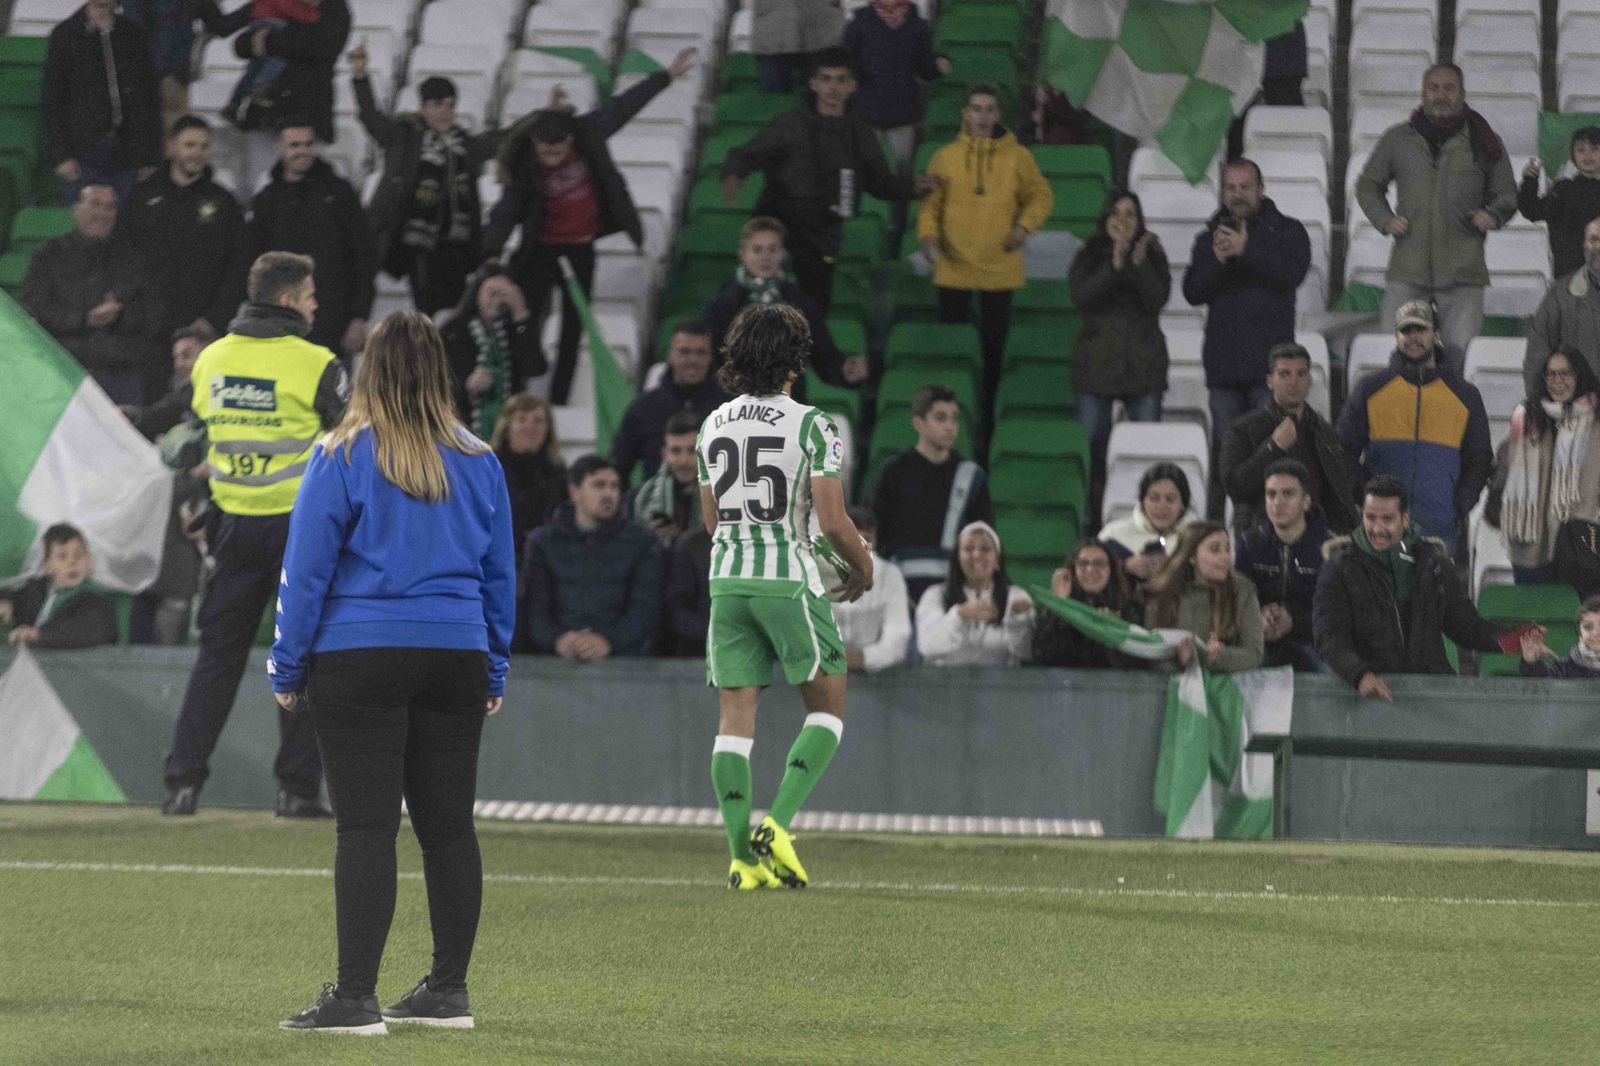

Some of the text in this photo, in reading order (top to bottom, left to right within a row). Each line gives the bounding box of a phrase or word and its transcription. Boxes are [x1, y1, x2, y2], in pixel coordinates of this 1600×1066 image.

[714, 404, 786, 429] D.LAINEZ
[229, 453, 273, 476] 197
[708, 436, 788, 525] 25
